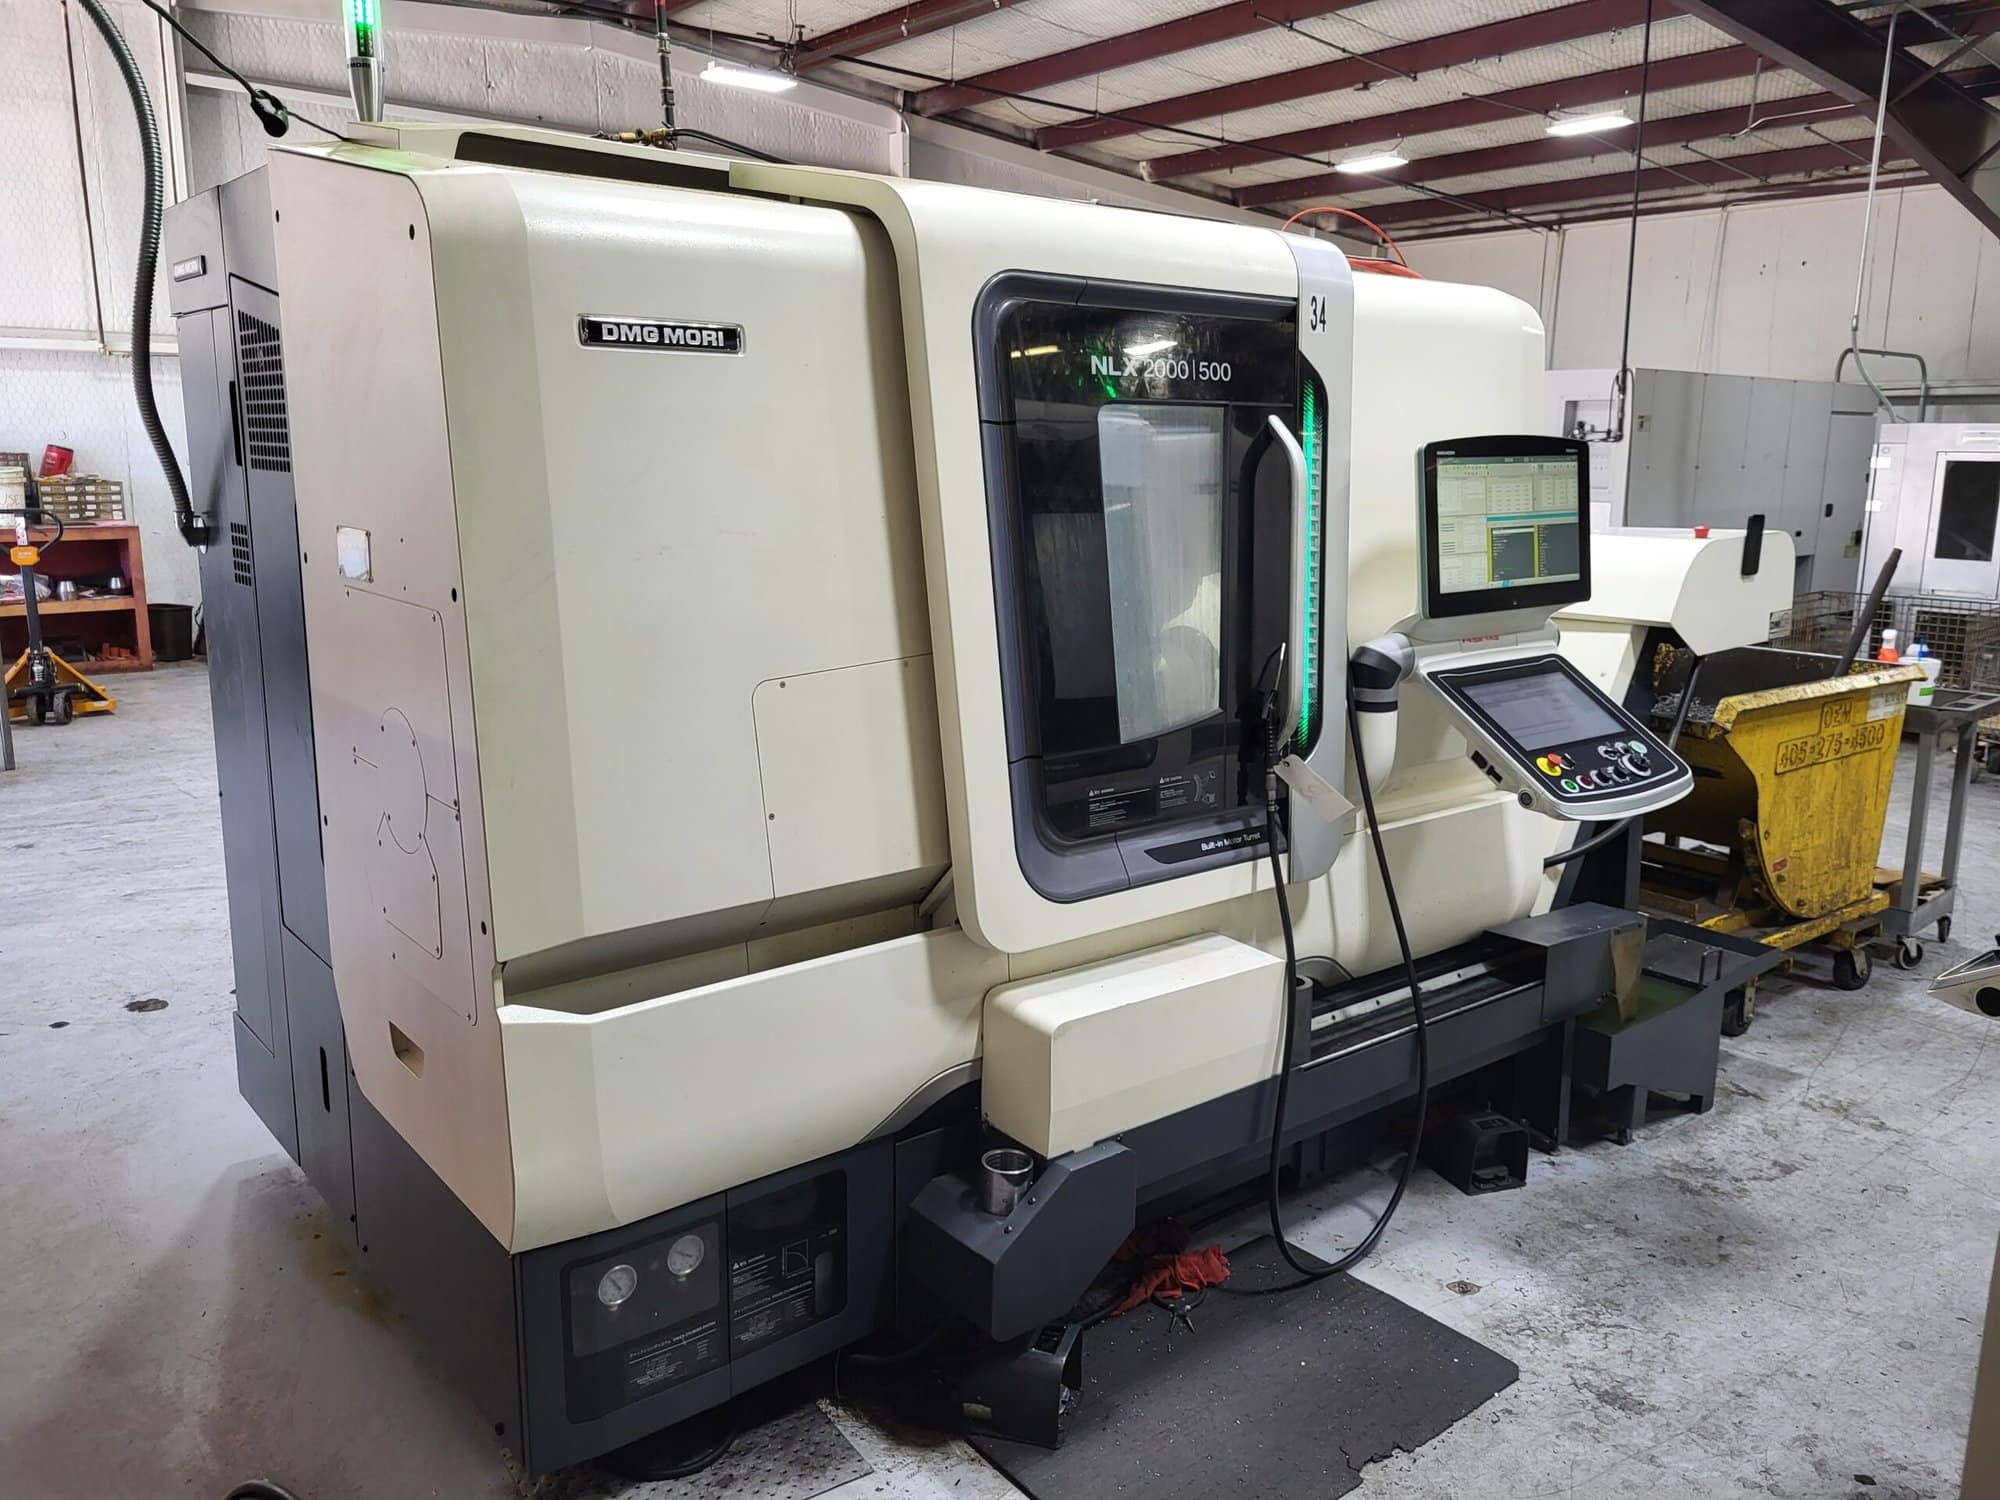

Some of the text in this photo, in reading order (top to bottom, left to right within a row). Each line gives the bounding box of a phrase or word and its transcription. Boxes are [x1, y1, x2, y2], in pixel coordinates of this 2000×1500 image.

[1310, 295, 1327, 333] 34
[601, 323, 725, 347] DMG MORI
[1090, 355, 1138, 377] NLX
